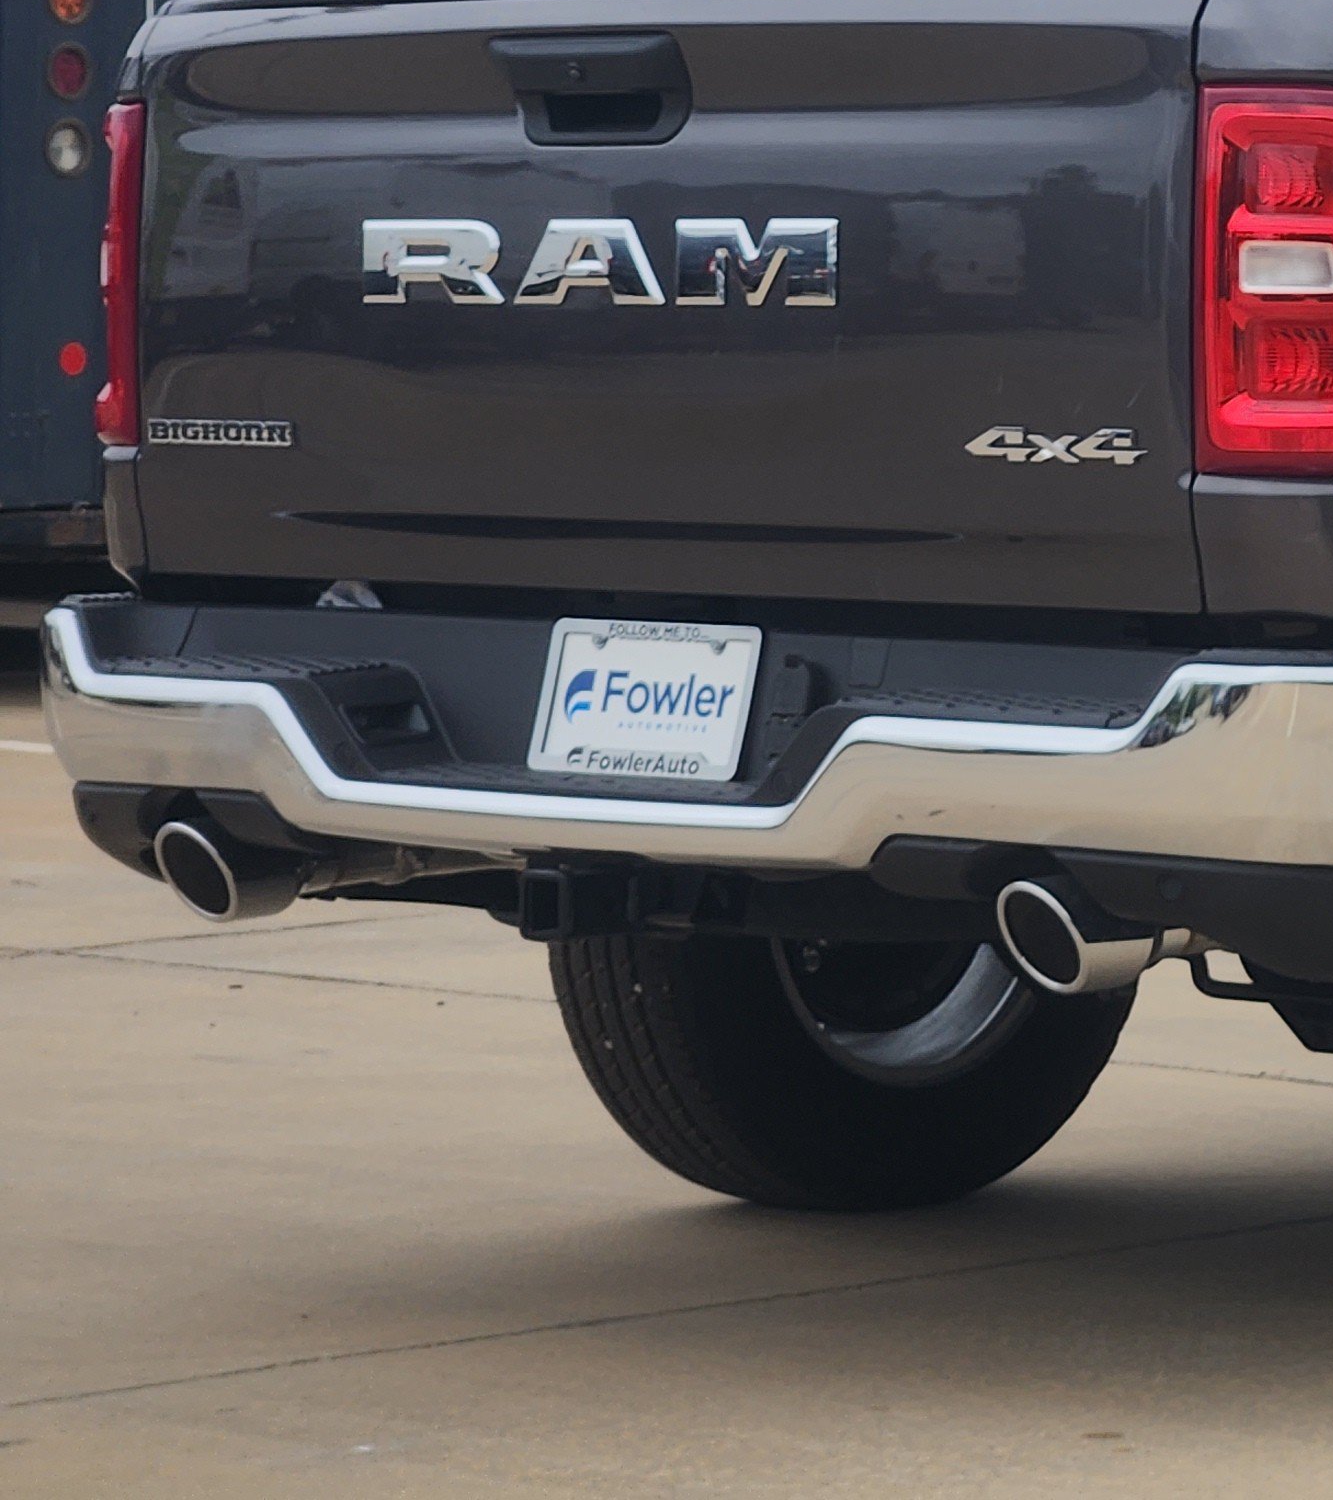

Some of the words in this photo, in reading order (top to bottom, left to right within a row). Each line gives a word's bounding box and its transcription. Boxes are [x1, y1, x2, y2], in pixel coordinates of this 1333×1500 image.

[362, 218, 839, 306] RAM
[148, 418, 292, 447] BIGHORN
[964, 425, 1149, 466] 4x4
[608, 622, 659, 637] FOLLOW
[663, 626, 682, 638] ME
[601, 670, 736, 719] Fowler
[617, 720, 708, 734] AUTOMOTIVE
[586, 750, 700, 776] FowlerAuto
